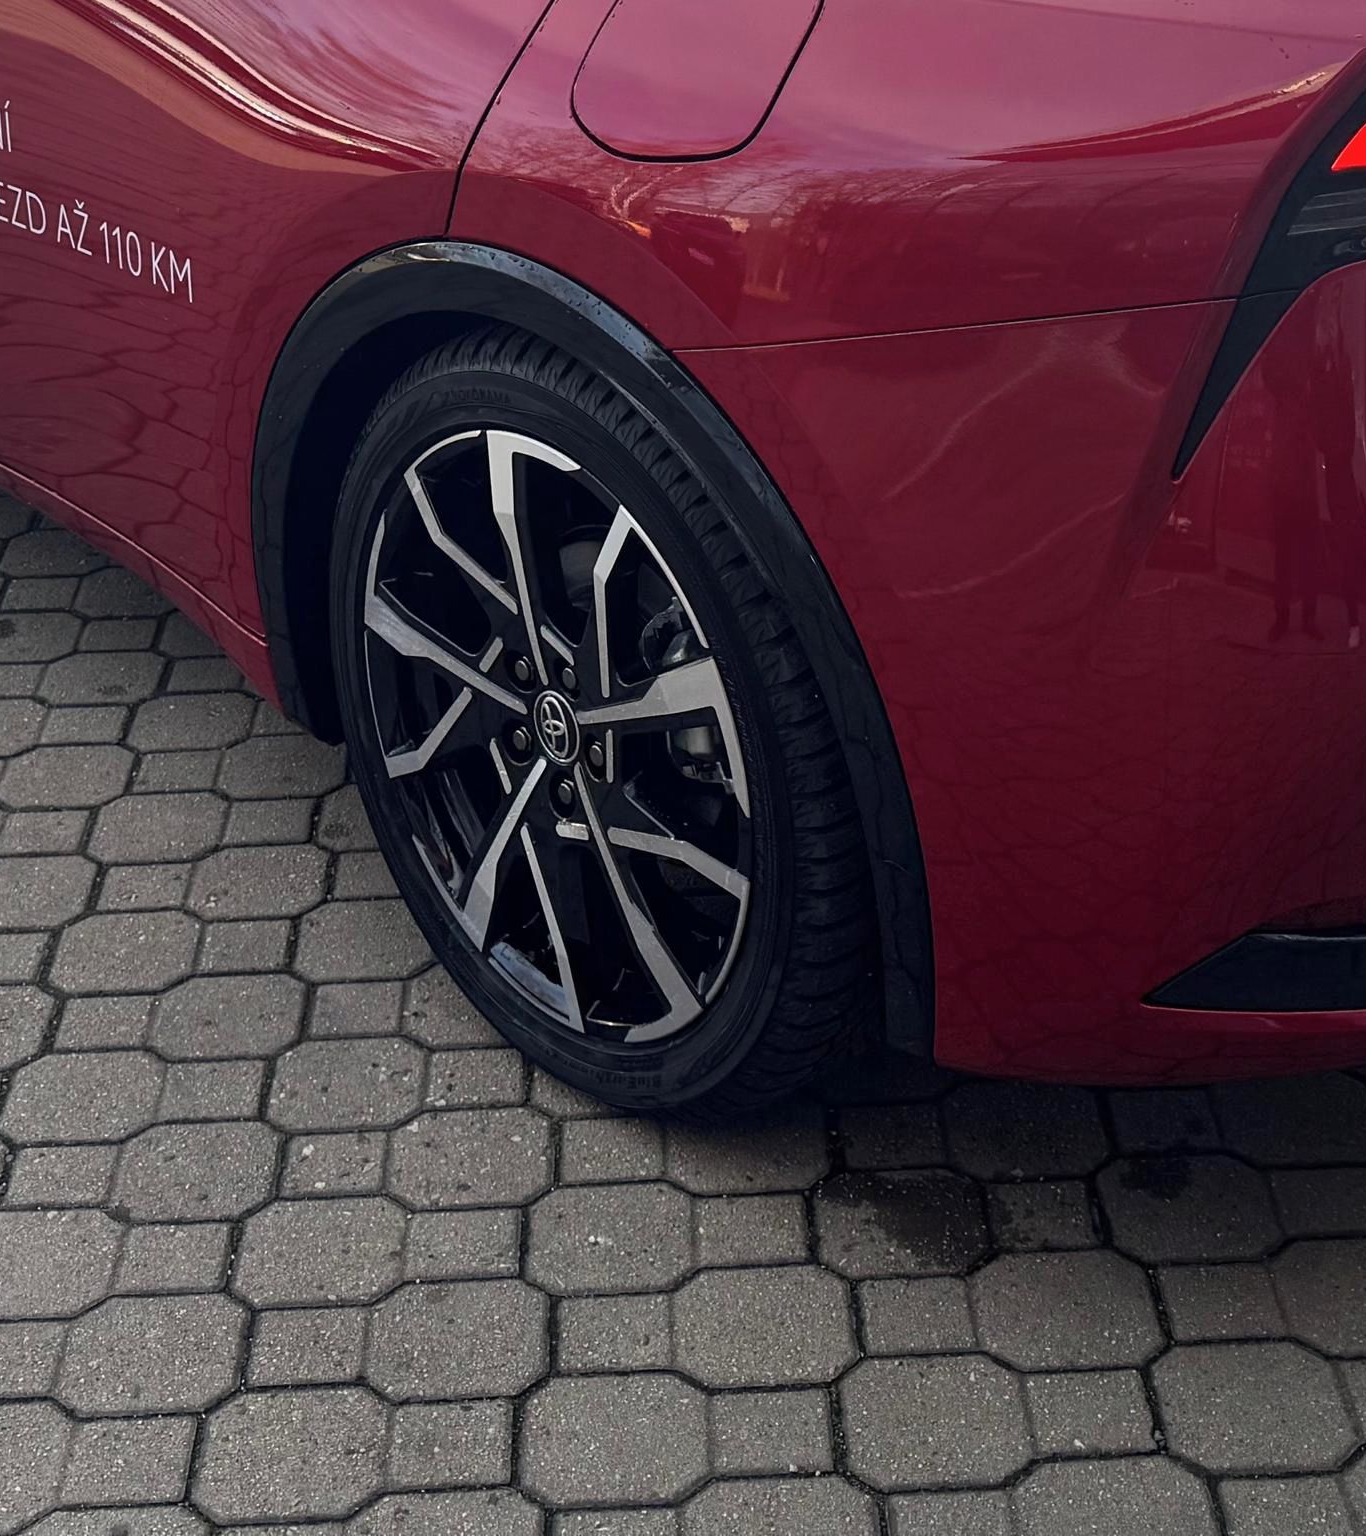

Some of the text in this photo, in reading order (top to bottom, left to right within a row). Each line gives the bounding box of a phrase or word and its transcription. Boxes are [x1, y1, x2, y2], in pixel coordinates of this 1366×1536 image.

[57, 199, 92, 256] AŽ
[99, 222, 142, 277] 110
[151, 241, 193, 303] KM
